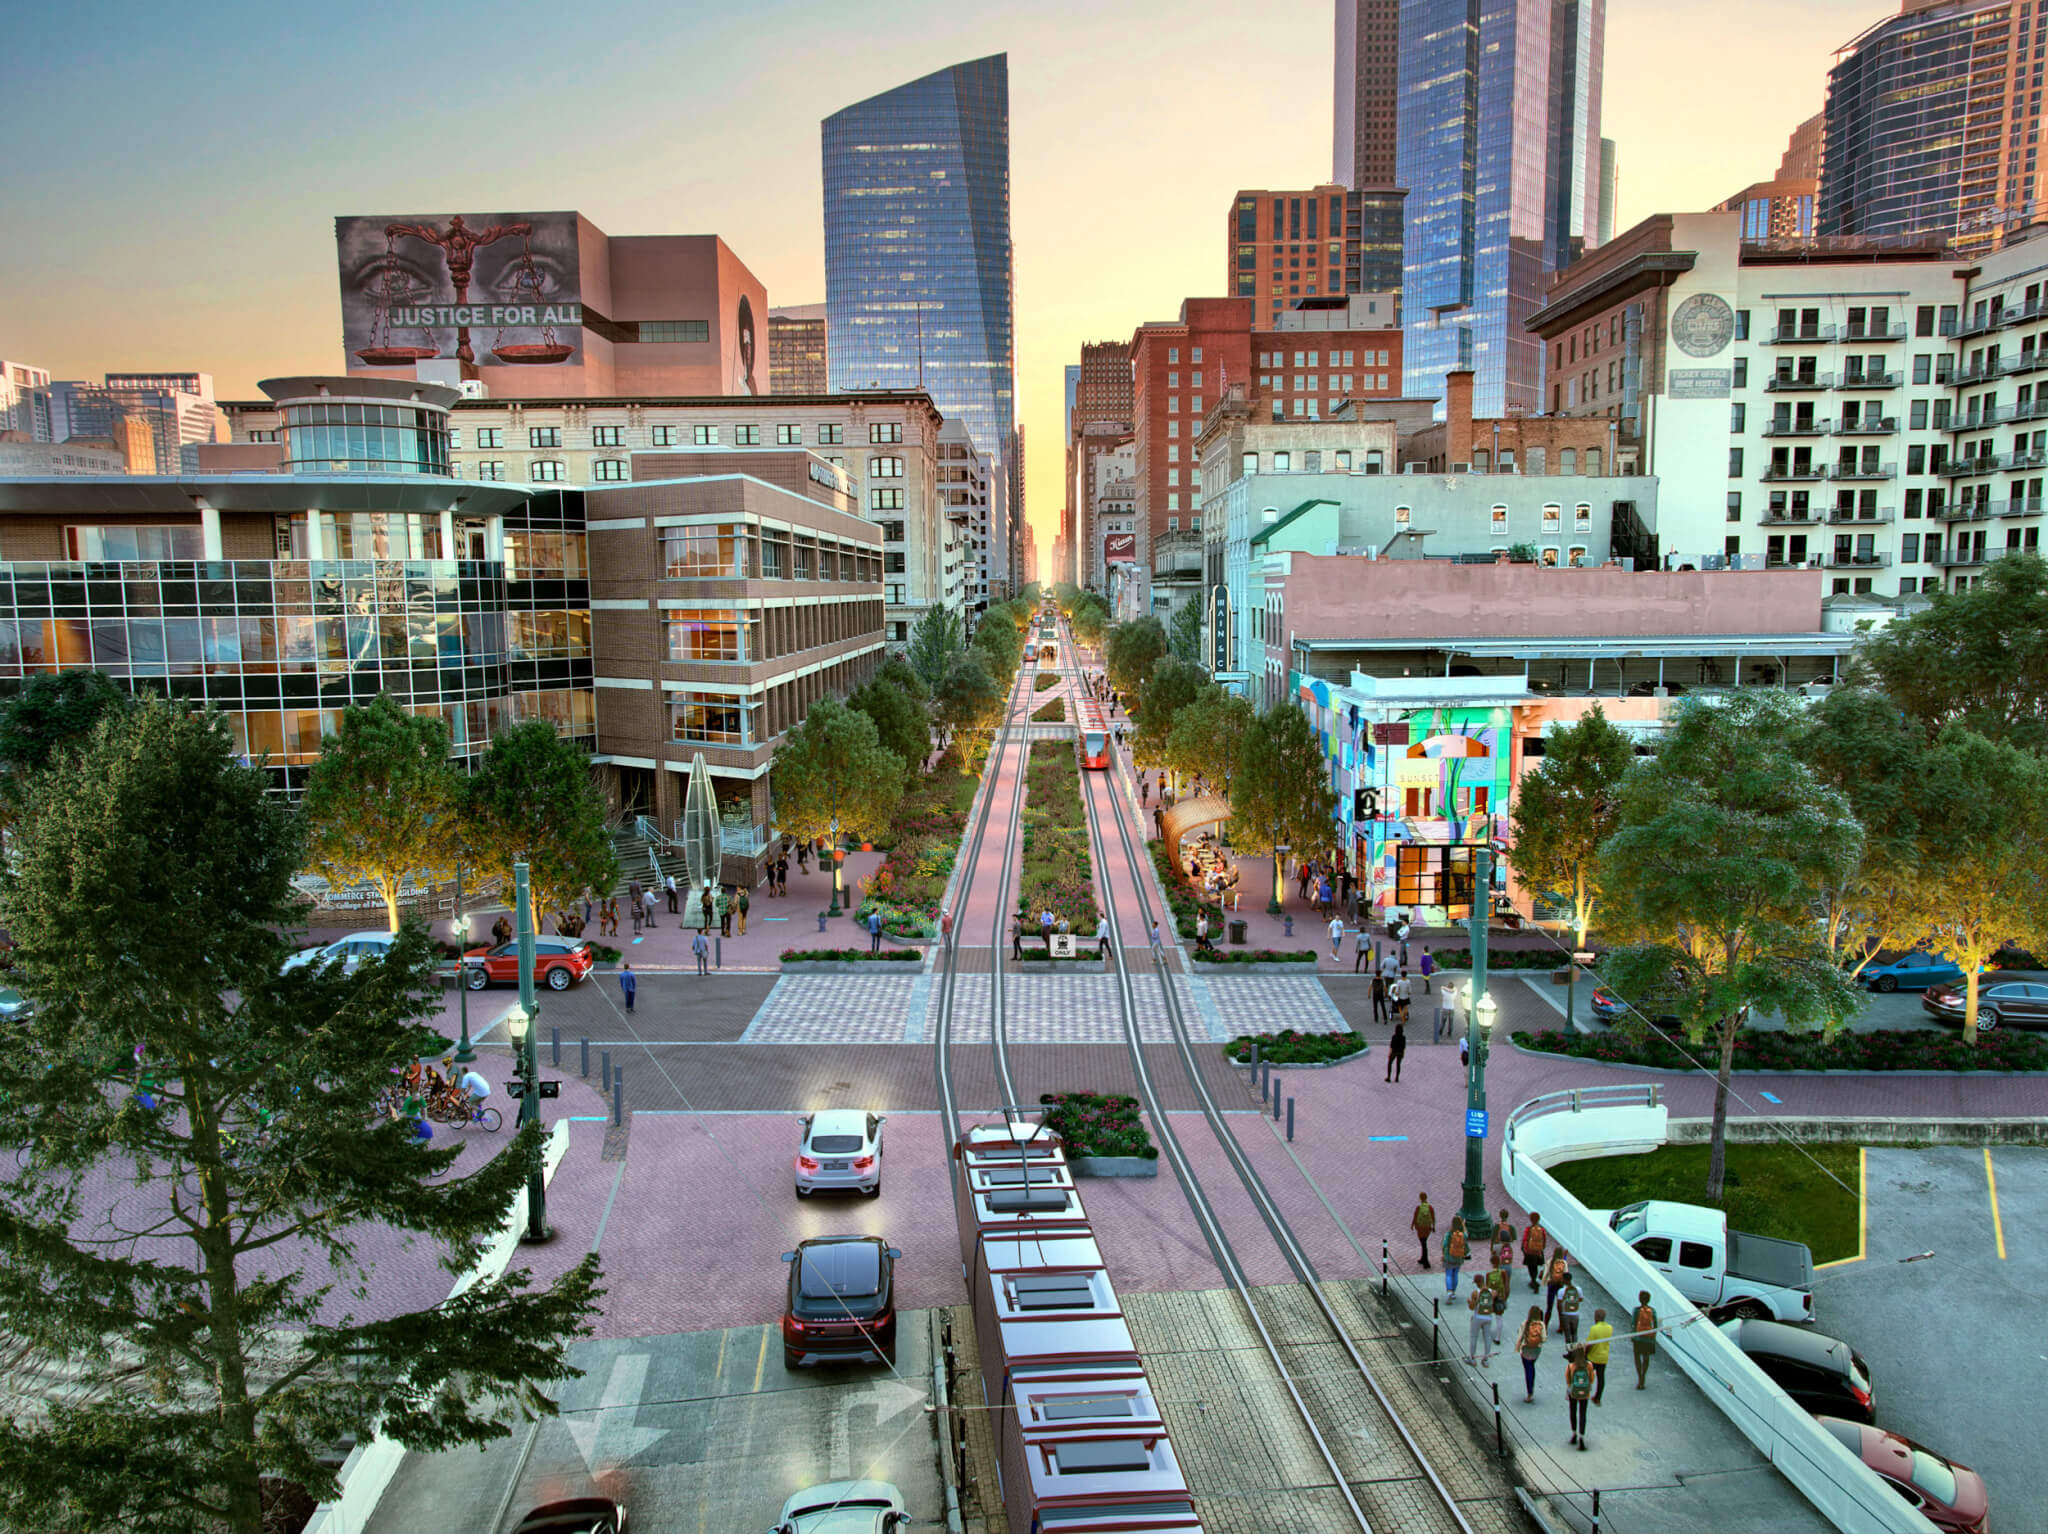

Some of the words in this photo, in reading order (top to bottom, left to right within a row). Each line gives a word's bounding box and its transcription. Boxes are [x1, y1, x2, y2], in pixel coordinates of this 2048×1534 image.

[392, 306, 485, 326] JUSTICE
[491, 306, 537, 324] FOR
[542, 305, 582, 324] ALL
[1217, 599, 1225, 637] MAIN
